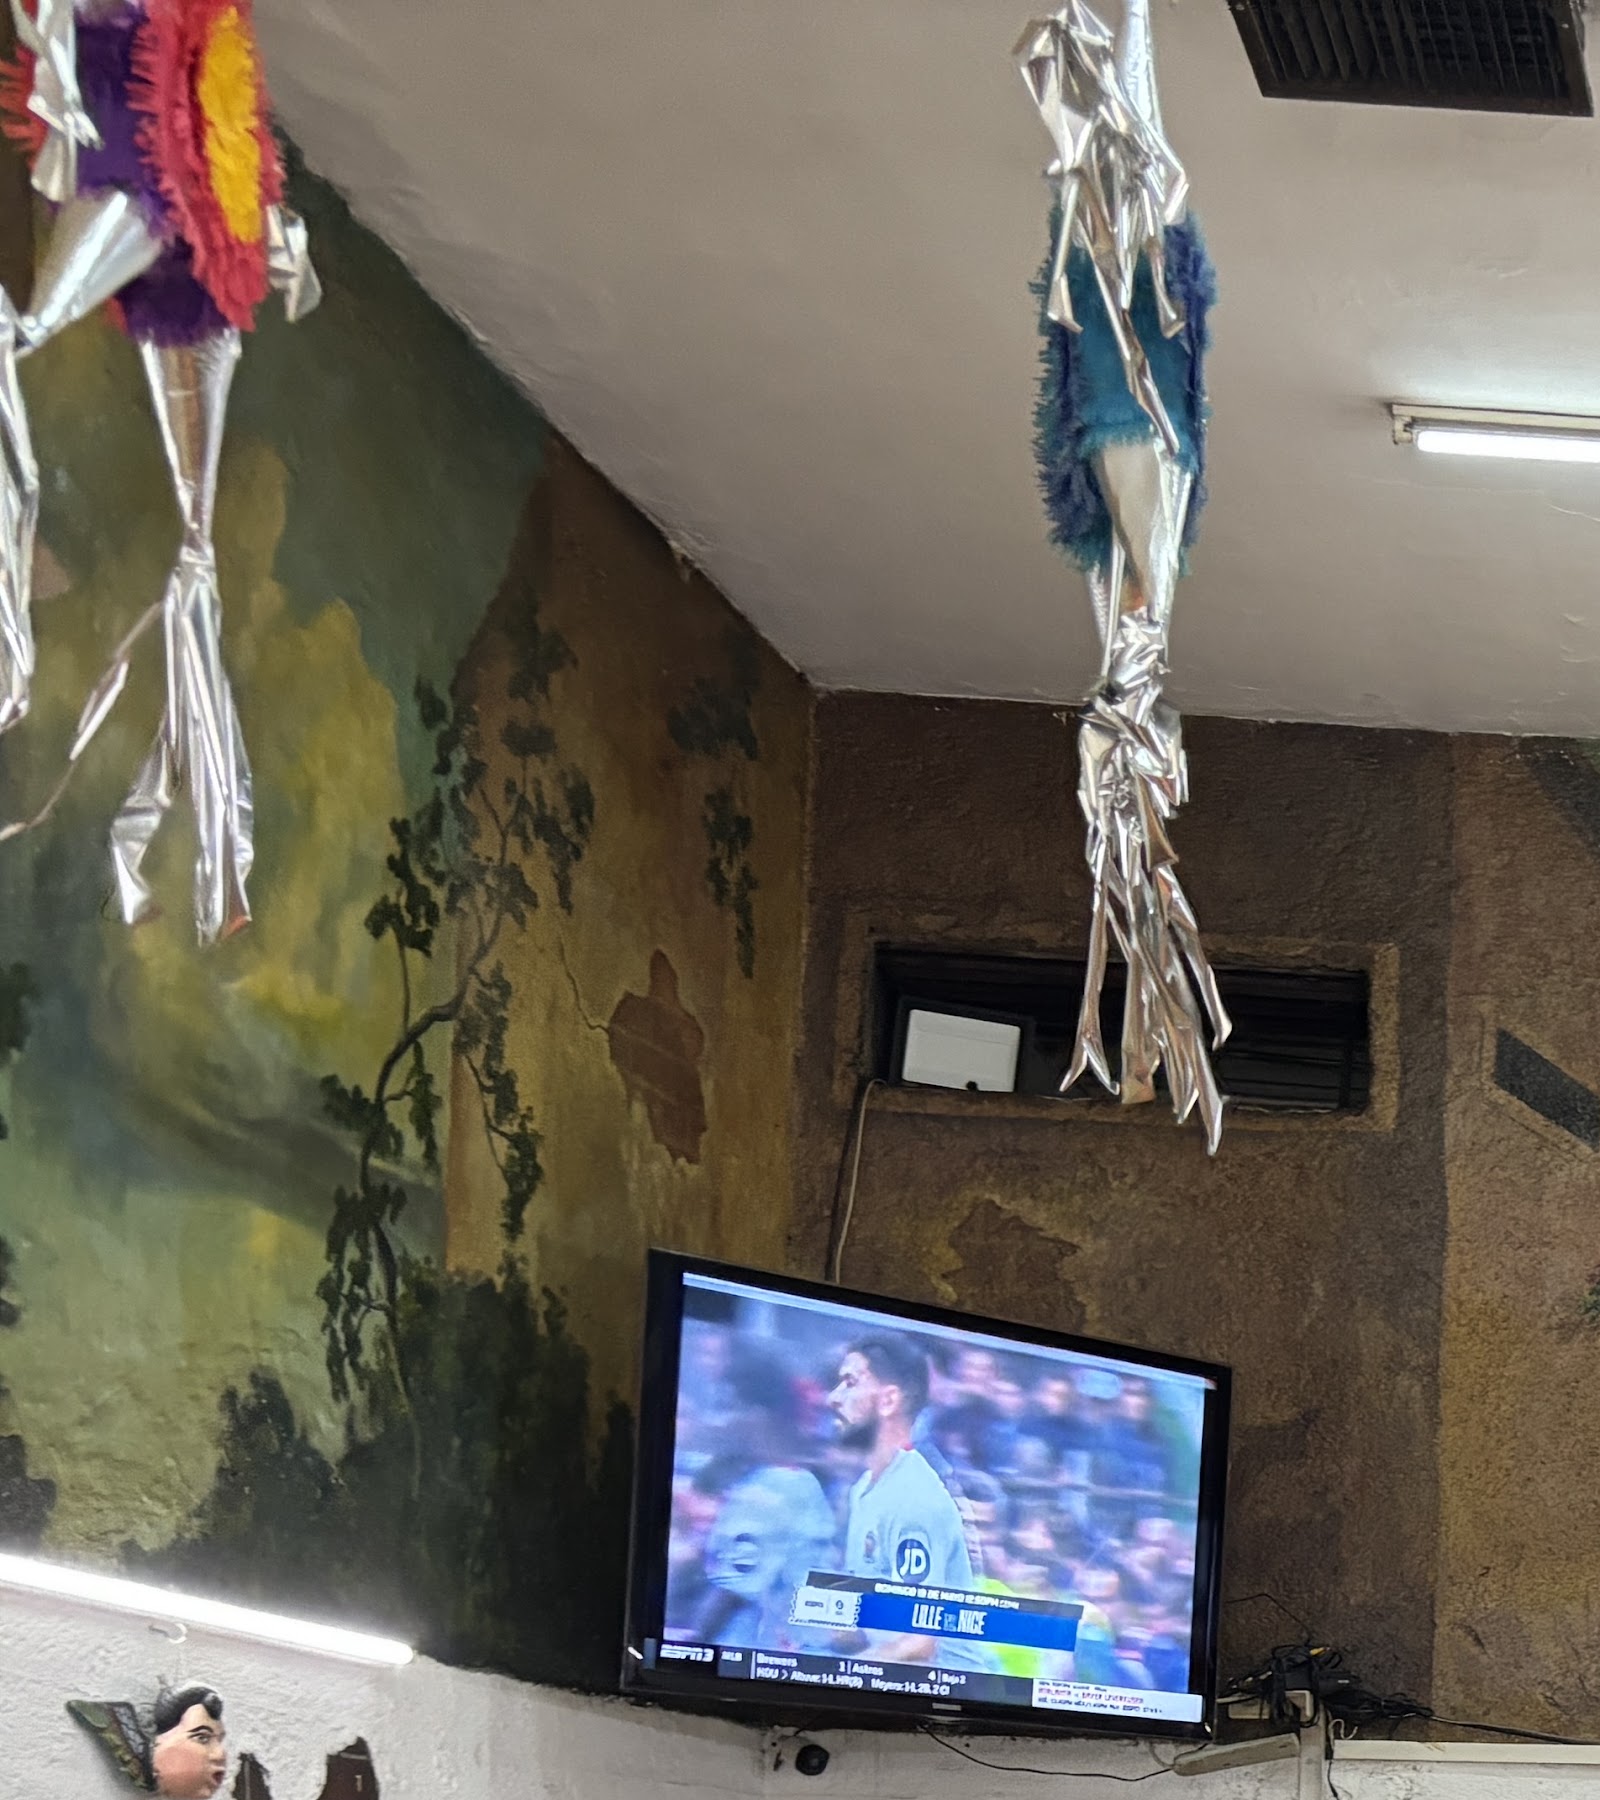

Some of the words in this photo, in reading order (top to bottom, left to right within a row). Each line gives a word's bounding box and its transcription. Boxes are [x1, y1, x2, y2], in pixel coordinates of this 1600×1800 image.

[899, 1548, 926, 1576] JD
[911, 1603, 944, 1630] LILLE
[957, 1609, 988, 1635] NICE
[757, 1652, 798, 1667] Brewers
[852, 1663, 884, 1676] Astros
[928, 1670, 936, 1681] 4
